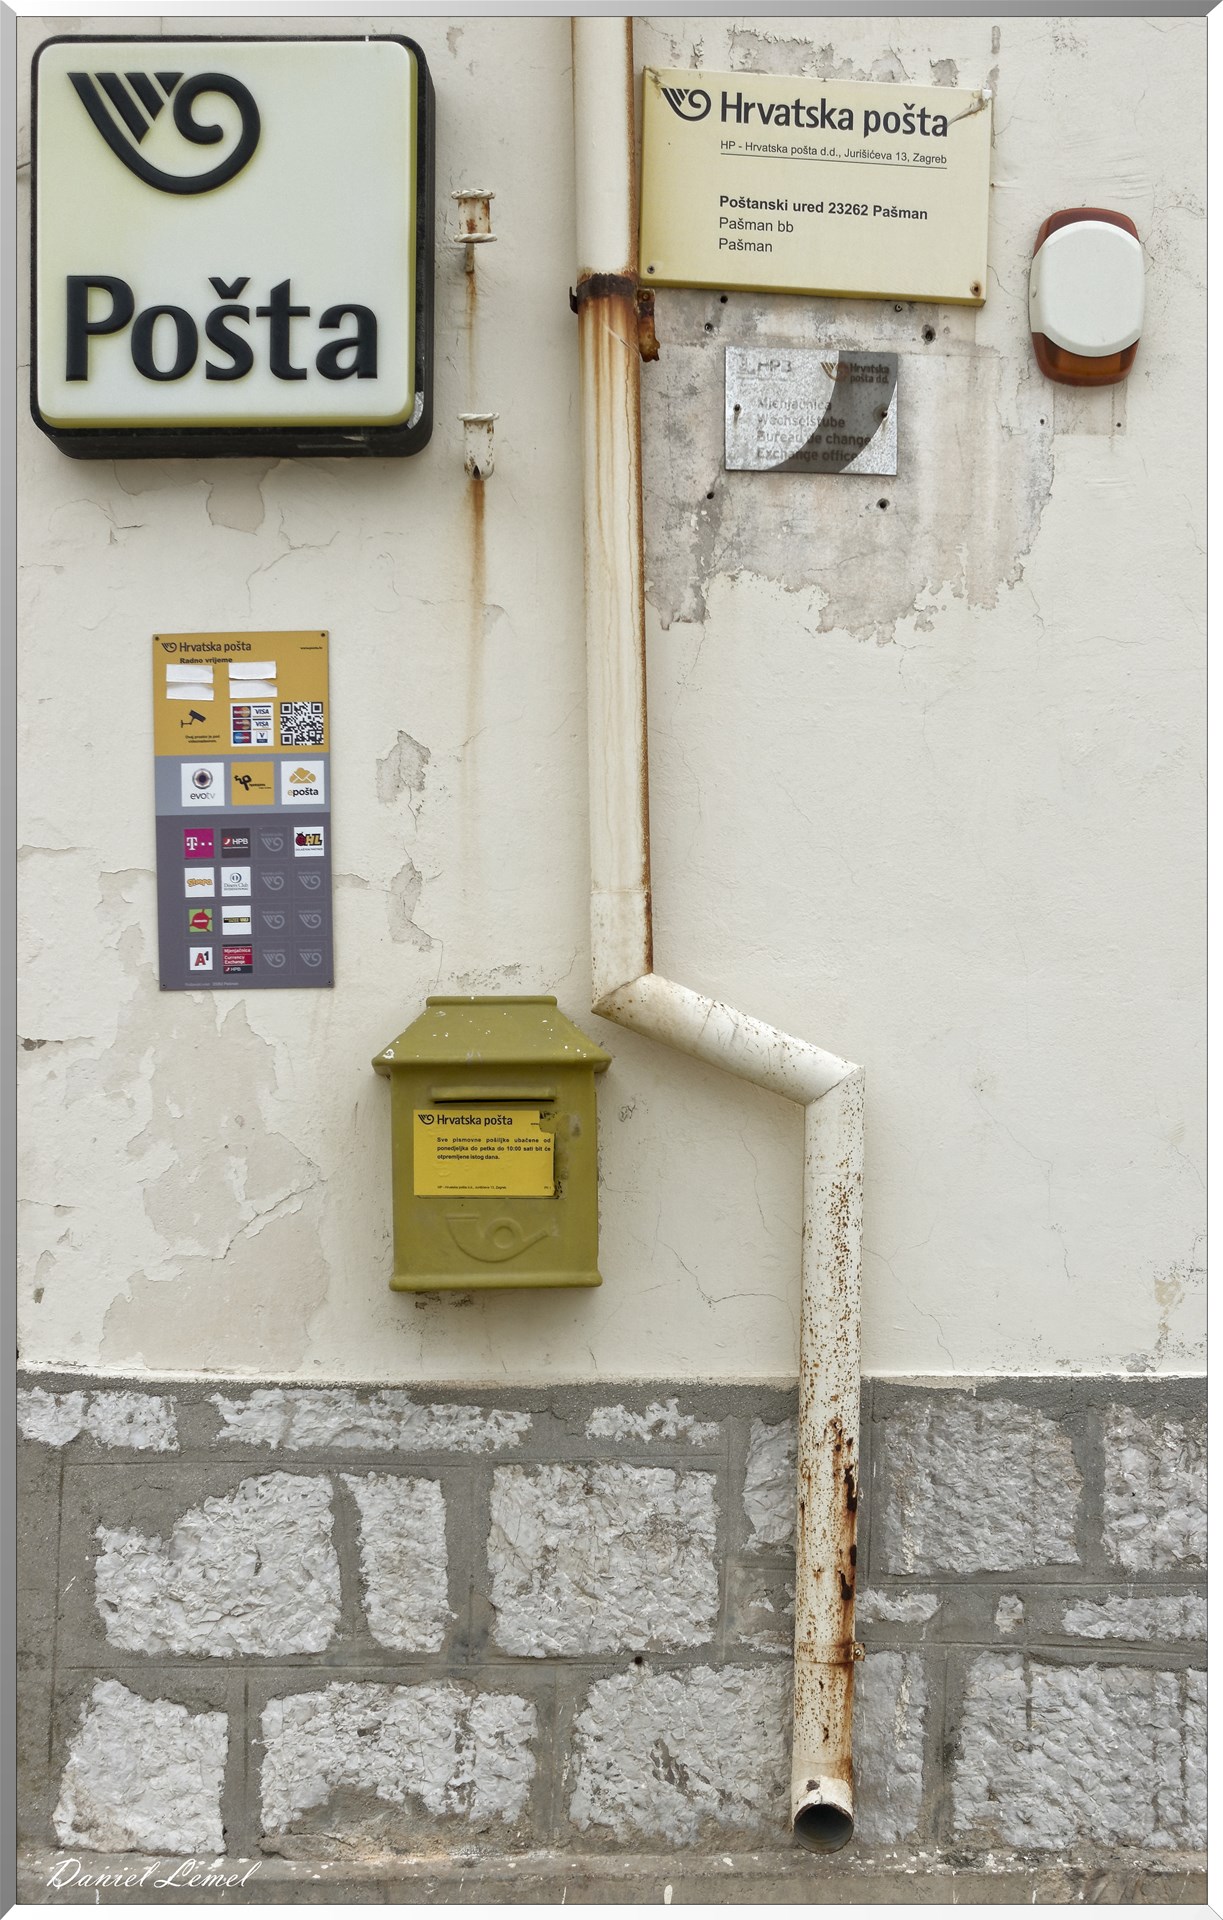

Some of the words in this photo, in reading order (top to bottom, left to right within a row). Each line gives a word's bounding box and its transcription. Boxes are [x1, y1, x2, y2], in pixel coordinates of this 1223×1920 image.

[720, 91, 854, 131] Hrvatska
[863, 102, 949, 139] pošta
[720, 140, 736, 150] HP
[745, 141, 788, 154] Hrvatska
[790, 144, 818, 157] pošta
[820, 146, 842, 159] d.d.,
[844, 148, 893, 161] Jurišićeva
[895, 151, 911, 163] 13,
[912, 153, 948, 166] Zagreb
[719, 195, 789, 212] Poštanski
[792, 199, 824, 214] ured
[828, 202, 869, 217] 23262
[872, 204, 928, 220] Pašman
[719, 216, 773, 232] Pašman
[777, 219, 795, 233] bb
[718, 237, 773, 252] Pašman
[66, 275, 378, 382] Pošta
[850, 363, 889, 375] Hrvatska
[825, 433, 871, 448] change
[823, 449, 857, 462] office
[179, 642, 222, 652] Hrvatska
[224, 641, 252, 653] pošta
[205, 657, 233, 665] vrijeme
[190, 792, 215, 800] evotv
[287, 787, 319, 798] epošta
[194, 950, 209, 966] A1
[437, 1115, 481, 1125] Hrvatska
[484, 1114, 513, 1126] pošta
